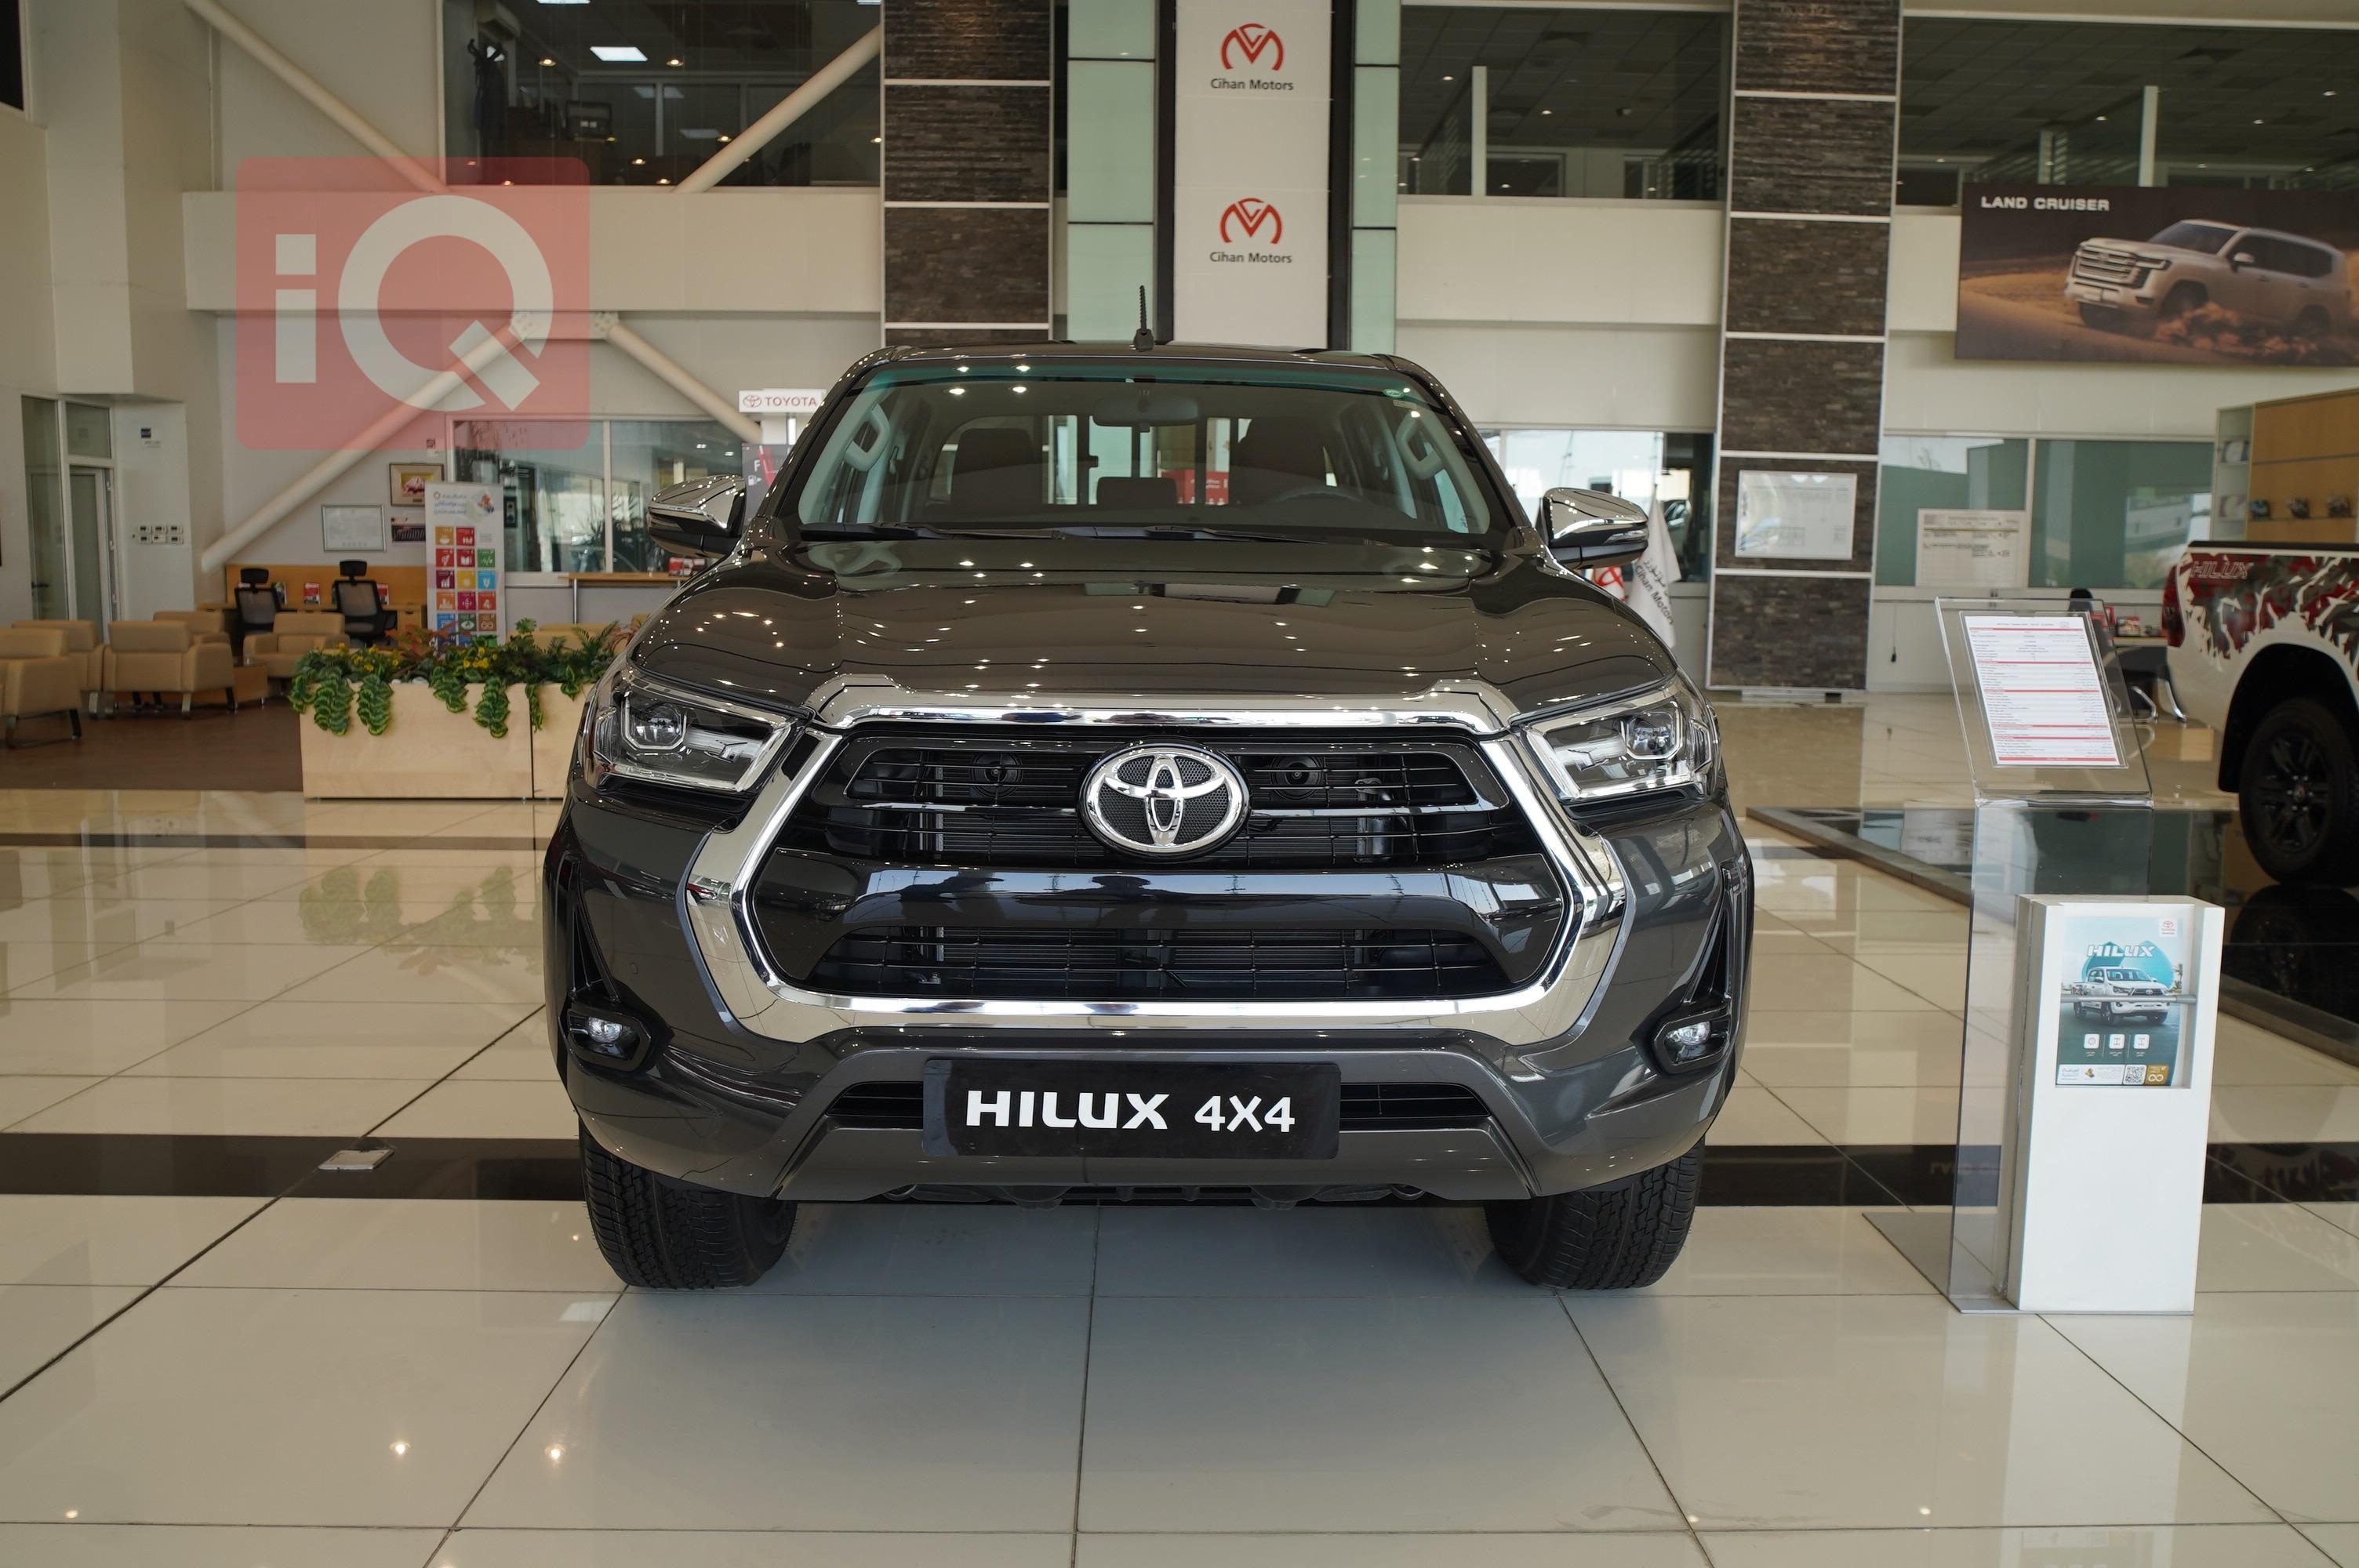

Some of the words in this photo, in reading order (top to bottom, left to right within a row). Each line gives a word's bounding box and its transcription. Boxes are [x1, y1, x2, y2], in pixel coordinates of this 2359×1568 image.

[1210, 78, 1245, 89] Cihan
[1249, 79, 1294, 91] Motors
[1981, 196, 2028, 210] LAND
[2034, 198, 2110, 212] CRUISER
[1209, 251, 1244, 263] Cihan
[1248, 252, 1292, 264] Motors
[765, 396, 817, 407] TOYOTA
[2190, 560, 2254, 579] HILUX
[1635, 564, 1653, 592] Cihan
[2086, 944, 2156, 958] HILUX
[966, 1090, 1169, 1130] HILUX
[1194, 1094, 1296, 1133] 4X4
